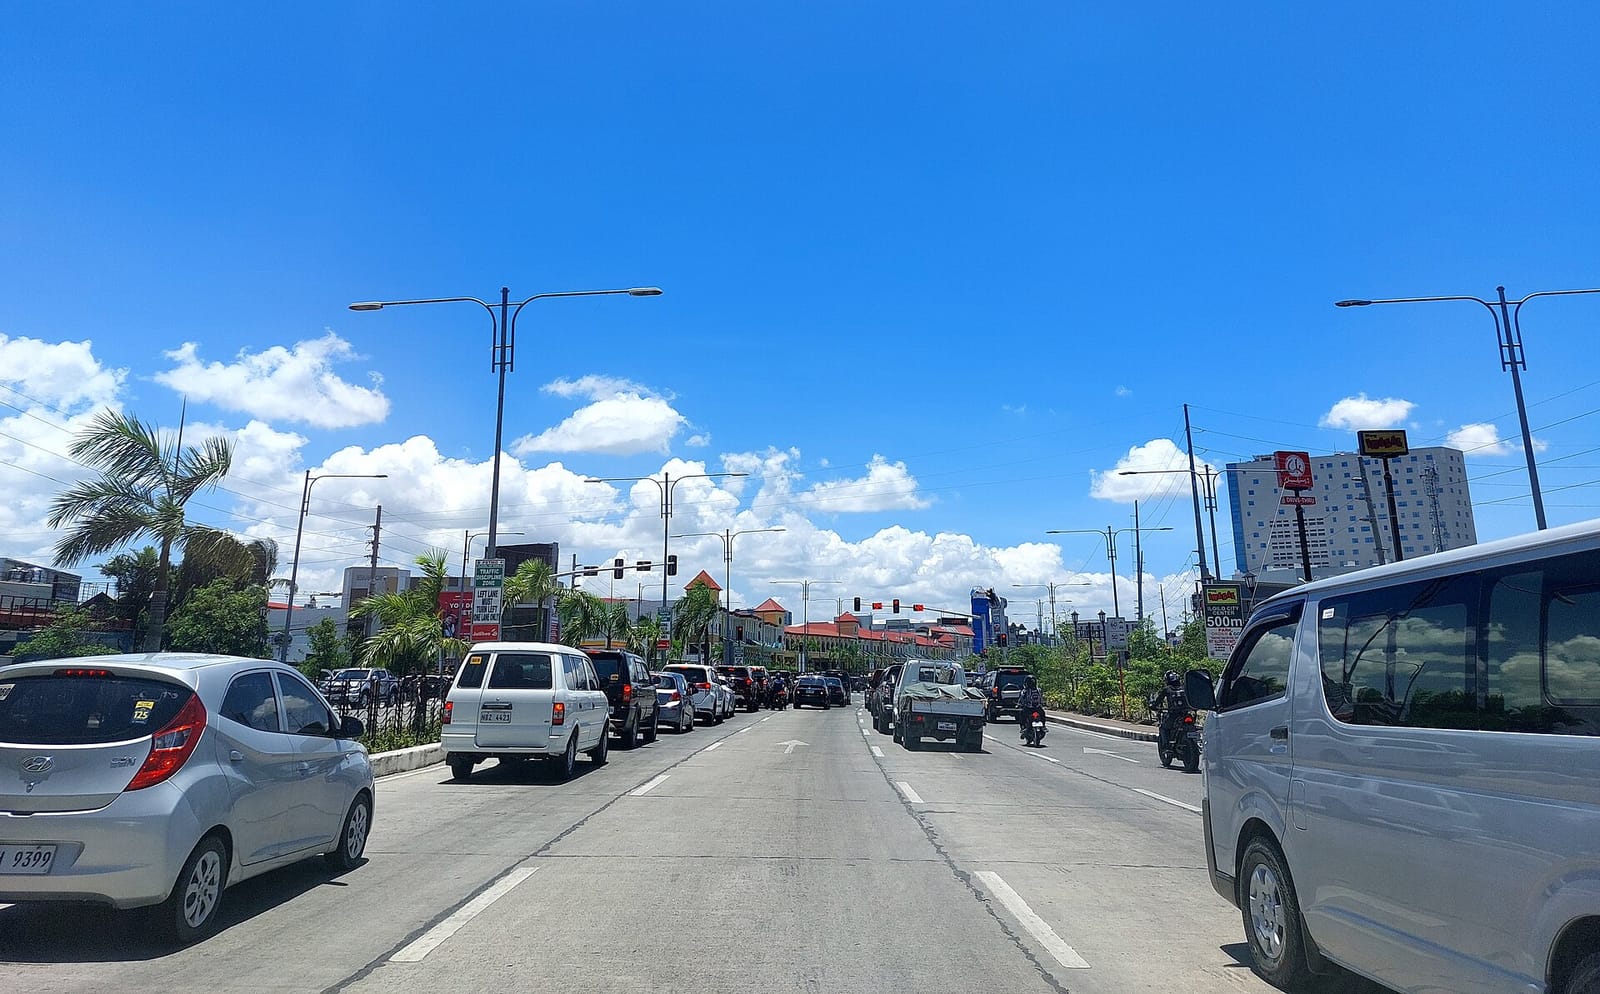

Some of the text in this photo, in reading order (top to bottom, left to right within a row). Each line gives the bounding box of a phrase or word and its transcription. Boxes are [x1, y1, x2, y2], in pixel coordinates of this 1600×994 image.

[477, 590, 487, 598] LEFT
[488, 590, 498, 598] LANE
[477, 605, 487, 613] TURN
[488, 605, 498, 613] LEFT
[1207, 616, 1243, 627] 500m
[134, 710, 149, 719] 125
[12, 851, 51, 868] 9399
